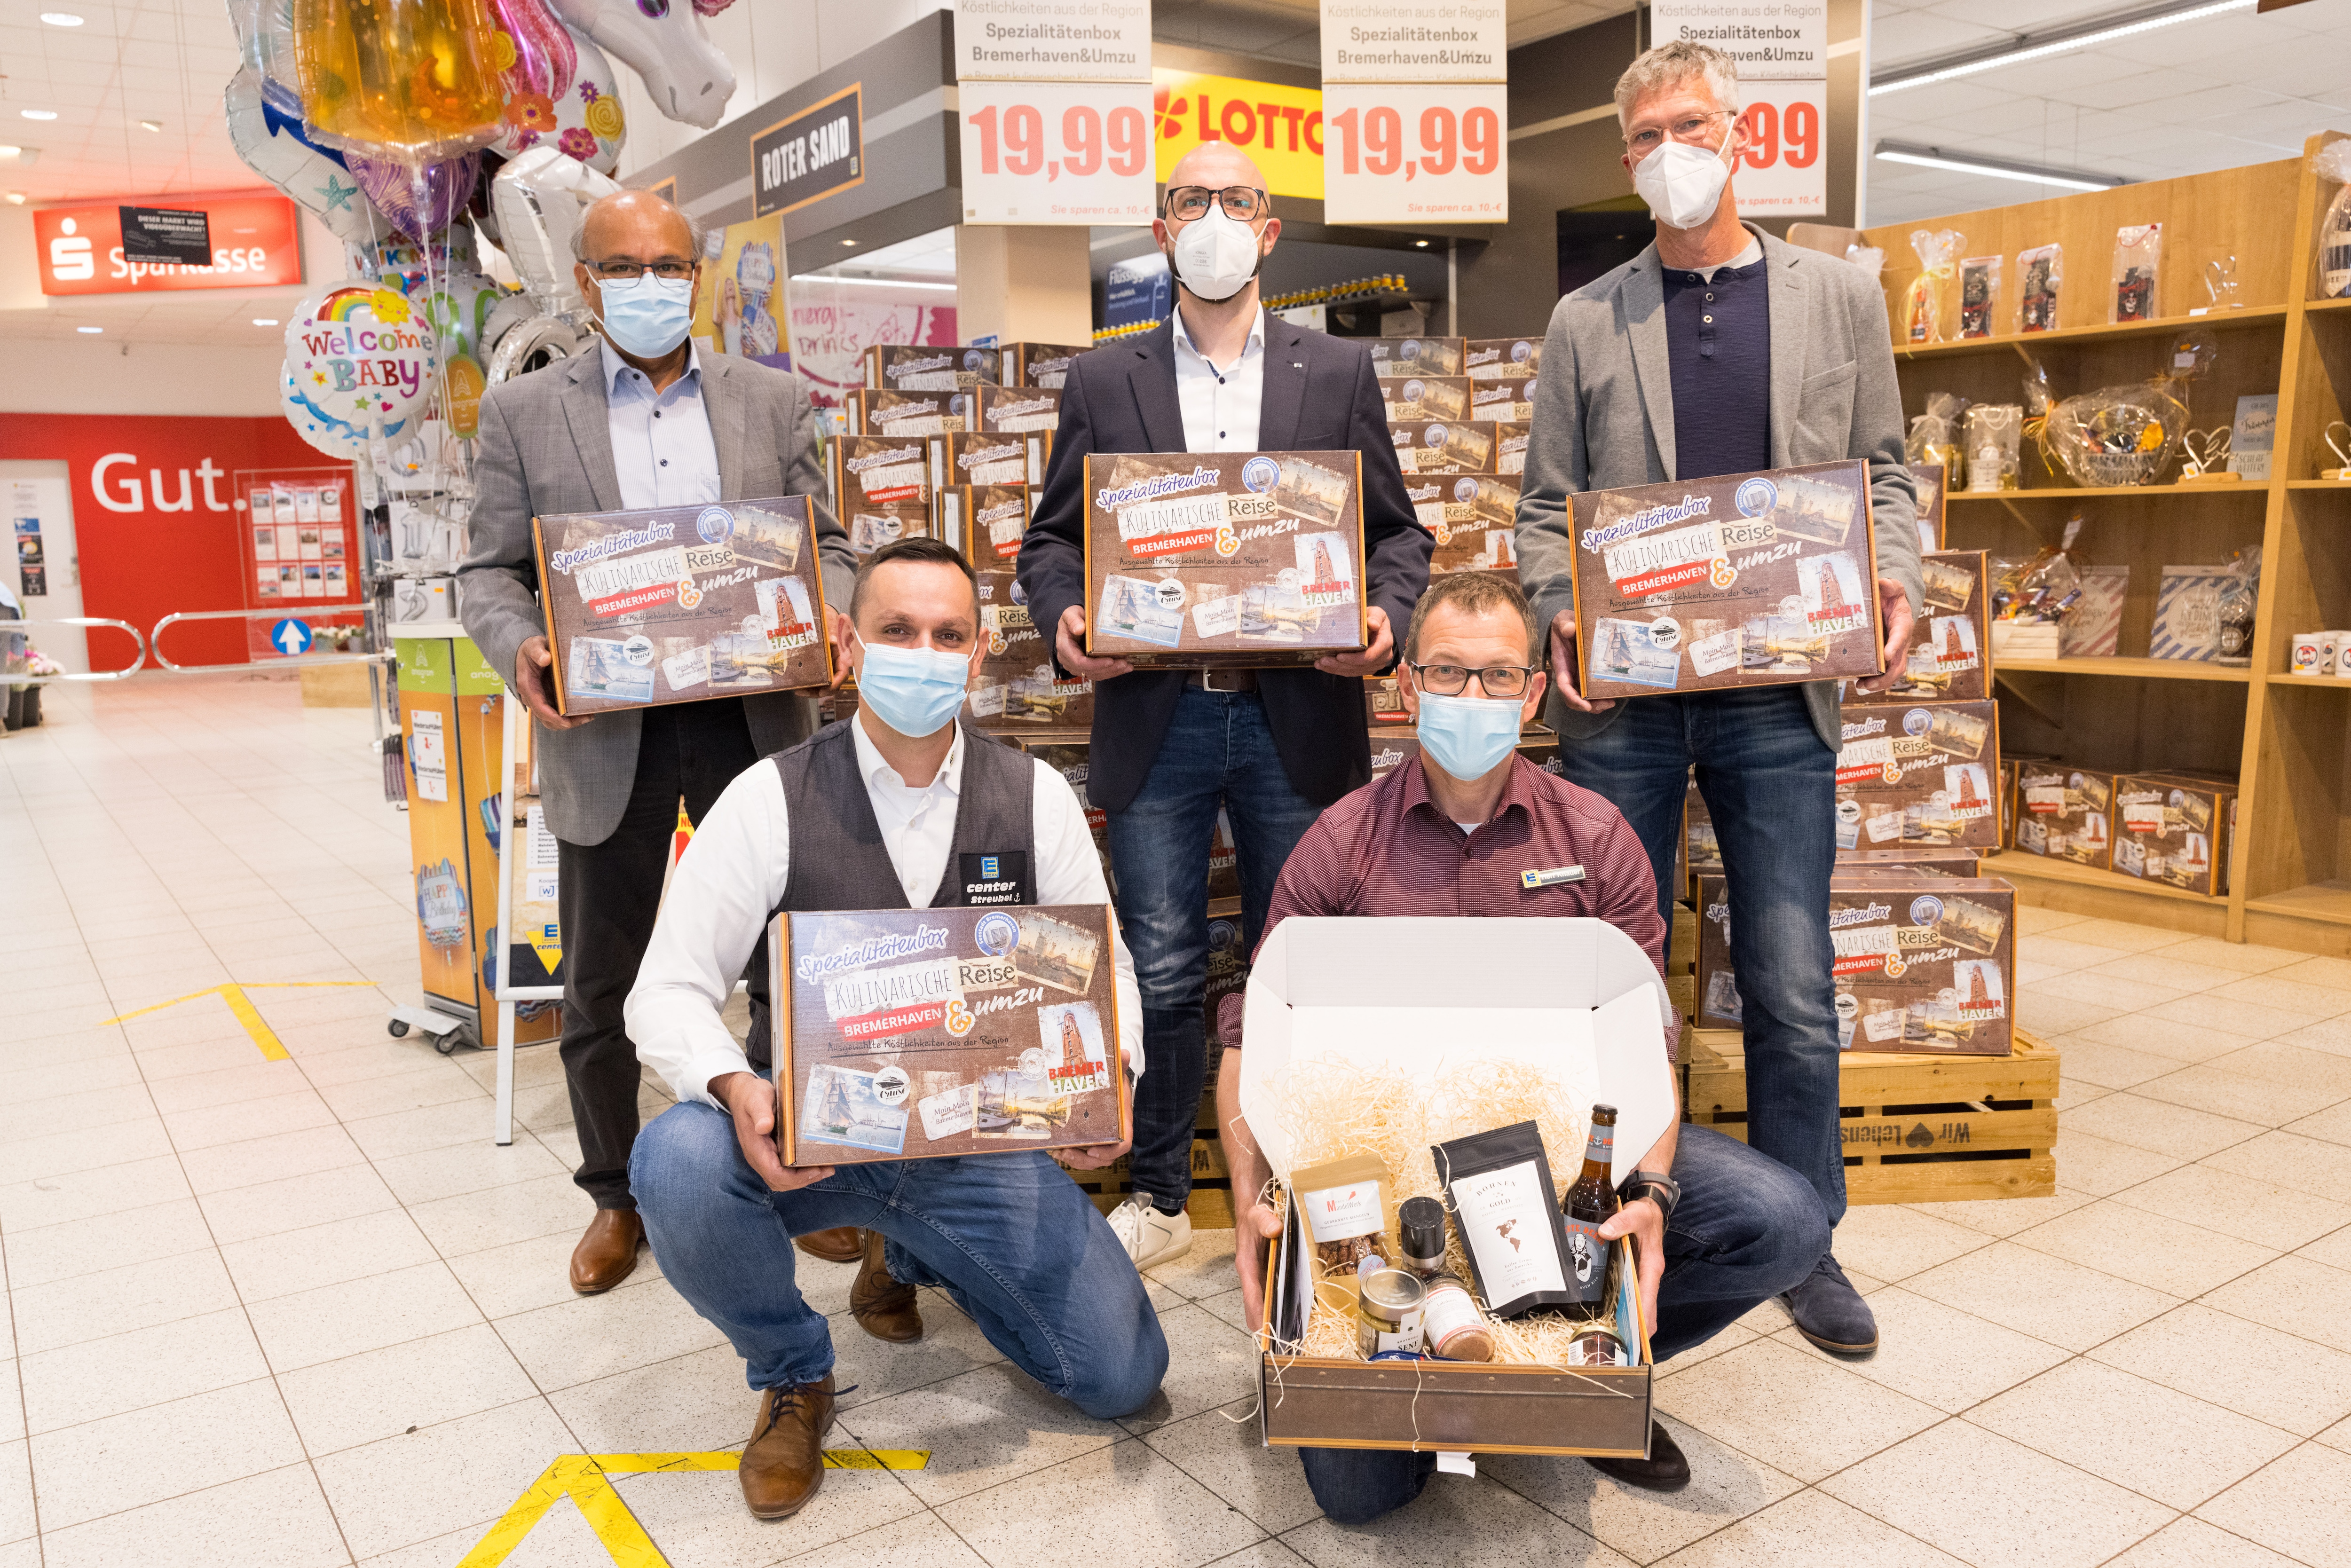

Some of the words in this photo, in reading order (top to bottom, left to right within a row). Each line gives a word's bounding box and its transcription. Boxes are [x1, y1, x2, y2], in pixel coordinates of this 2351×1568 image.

[962, 0, 1050, 14] Köstlichkeiten
[1054, 6, 1076, 15] aus
[1080, 3, 1098, 16] der
[1102, 3, 1143, 18] Region
[1328, 5, 1412, 18] Köstlichkeiten
[1415, 8, 1436, 18] aus
[1439, 6, 1457, 18] der
[1460, 6, 1499, 20] Region
[1658, 4, 1739, 17] Köstlichkeiten
[1741, 8, 1760, 16] aus
[1764, 5, 1781, 16] der
[1784, 4, 1821, 18] Region
[986, 23, 1121, 40] Spezialitätenbox
[1350, 26, 1478, 44] Spezialitätenbox
[1680, 25, 1800, 40] Spezialitätenbox
[972, 47, 1136, 63] Bremerhaven&Umzu
[1338, 49, 1491, 64] Bremerhaven&Umzu
[1199, 94, 1323, 156] LOTTO
[969, 105, 1146, 183] 19,99
[1332, 106, 1499, 182] 19,99
[762, 136, 807, 191] ROTER
[810, 115, 850, 171] SAND
[1408, 203, 1423, 213] Sie
[1426, 204, 1459, 214] sparen
[1479, 203, 1501, 213] 10,-€
[1749, 197, 1779, 206] sparen
[1799, 196, 1820, 205] 10,-€
[1051, 205, 1071, 215] Sie
[1074, 206, 1110, 217] sparen
[1113, 206, 1123, 214] ca.
[1126, 205, 1150, 216] 10,-€
[138, 214, 160, 223] DIESER
[162, 216, 185, 225] MARKT
[1393, 364, 1419, 374] Reise
[957, 374, 981, 386] Reise
[1395, 405, 1423, 416] Reise
[1416, 450, 1445, 461] Reise
[92, 452, 246, 513] Gut.
[1098, 468, 1217, 508] Spezialitätenbox
[870, 489, 918, 501] BREMERHAVEN
[1127, 503, 1221, 532] KULINARISCHE
[1227, 500, 1275, 516] Reise
[1444, 504, 1475, 517] Reise
[1452, 519, 1491, 535] umzu
[1584, 497, 1708, 549] Spezialitätenbox
[1133, 534, 1213, 553] BREMERHAVEN
[1219, 528, 1238, 554] &
[1241, 519, 1300, 540] umzu
[554, 523, 671, 570] Spezialitätenbox
[1614, 532, 1715, 572] KULINARISCHE
[1720, 524, 1774, 545] Reise
[1120, 557, 1162, 567] Ausgewählte
[1244, 557, 1268, 566] Region
[1623, 567, 1707, 594] BREMERHAVEN
[1713, 559, 1734, 586] &
[1737, 541, 1801, 570] umzu
[584, 556, 681, 593] KULINARISCHE
[685, 550, 734, 568] Reise
[595, 588, 675, 614] BREMERHAVEN
[680, 581, 700, 606] &
[702, 566, 758, 591] umzu
[1302, 581, 1350, 594] BREMER
[1609, 596, 1654, 608] Ausgewählte
[1657, 591, 1710, 601] Köstlichkeiten
[1743, 587, 1769, 596] Region
[630, 611, 679, 621] Köstlichkeiten
[1206, 616, 1236, 626] Bremerhaven
[1807, 604, 1862, 622] BREMER
[766, 622, 813, 639] BREMER
[1705, 652, 1737, 663] Bremerhaven
[678, 667, 707, 678] Bremerhaven
[1892, 741, 1929, 754] Reise
[1902, 754, 1949, 772] umzu
[1950, 799, 1988, 810] BREMER
[967, 882, 1016, 893] center
[971, 894, 1013, 904] Streubel
[1896, 931, 1938, 944] Reise
[800, 927, 945, 980] Spezialitätenbox
[1888, 954, 1904, 975] &
[1907, 948, 1959, 965] umzu
[836, 969, 951, 1009] KULINARISCHE
[958, 965, 1015, 985] Reise
[844, 1009, 942, 1036] BREMERHAVEN
[949, 1001, 971, 1033] &
[975, 987, 1043, 1016] umzu
[1959, 1001, 2002, 1009] BREMER
[828, 1040, 881, 1054] Ausgewählte
[884, 1038, 944, 1048] Köstlichkeiten
[964, 1037, 977, 1046] der
[980, 1036, 1008, 1047] Region
[1049, 1062, 1104, 1079] BREMER
[934, 1106, 950, 1115] Moin
[953, 1100, 969, 1109] Moin
[936, 1111, 972, 1125] Bremerhaven
[1476, 1180, 1516, 1197] BOHNEN
[1490, 1198, 1511, 1208] GOLD
